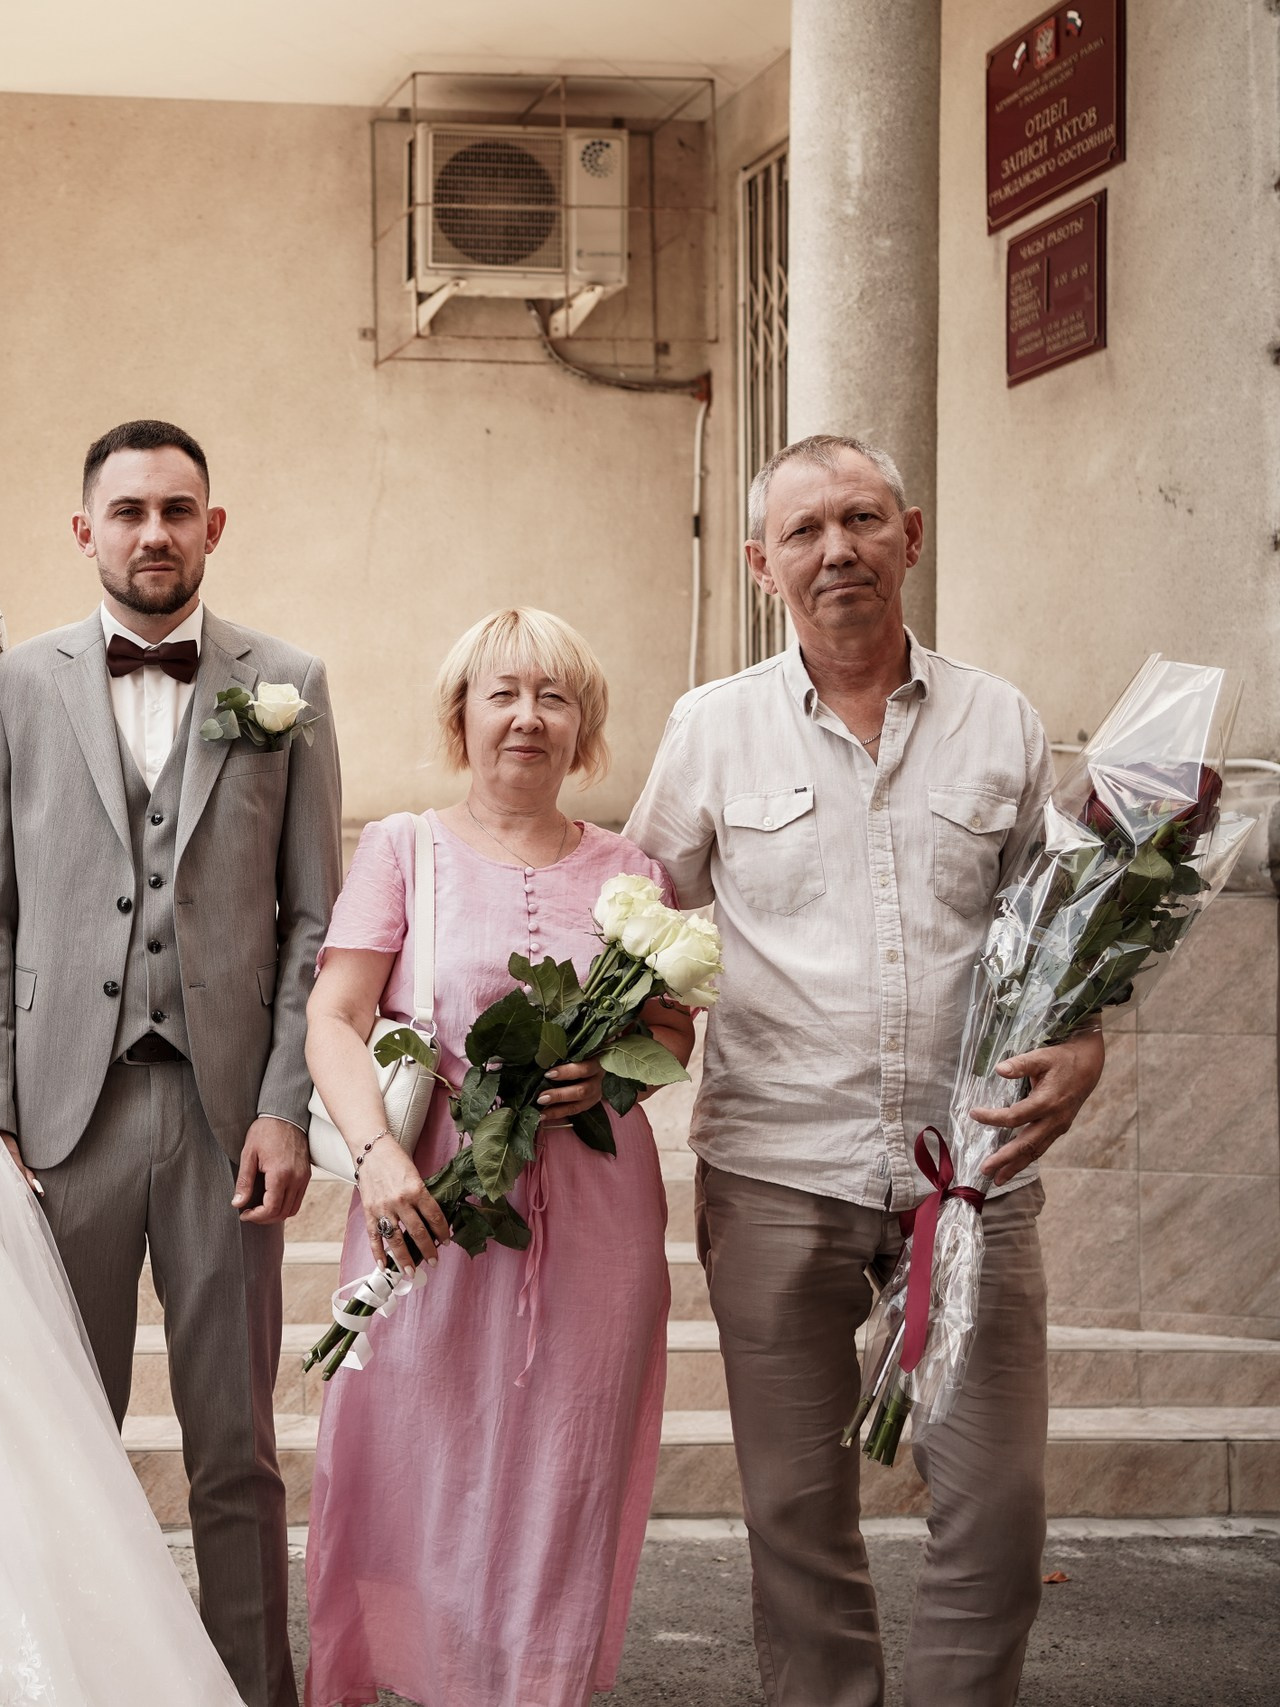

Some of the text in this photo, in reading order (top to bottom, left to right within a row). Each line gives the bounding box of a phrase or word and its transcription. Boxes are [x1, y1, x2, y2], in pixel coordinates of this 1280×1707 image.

[1001, 106, 1097, 179] ЗАПИСИ АКТОВ
[1024, 97, 1067, 138] ОТДЕЛ
[989, 124, 1114, 207] ГРАЖДАНСКОГО СОСТОЯНИЯ
[1046, 217, 1084, 250] РАБОТЫ
